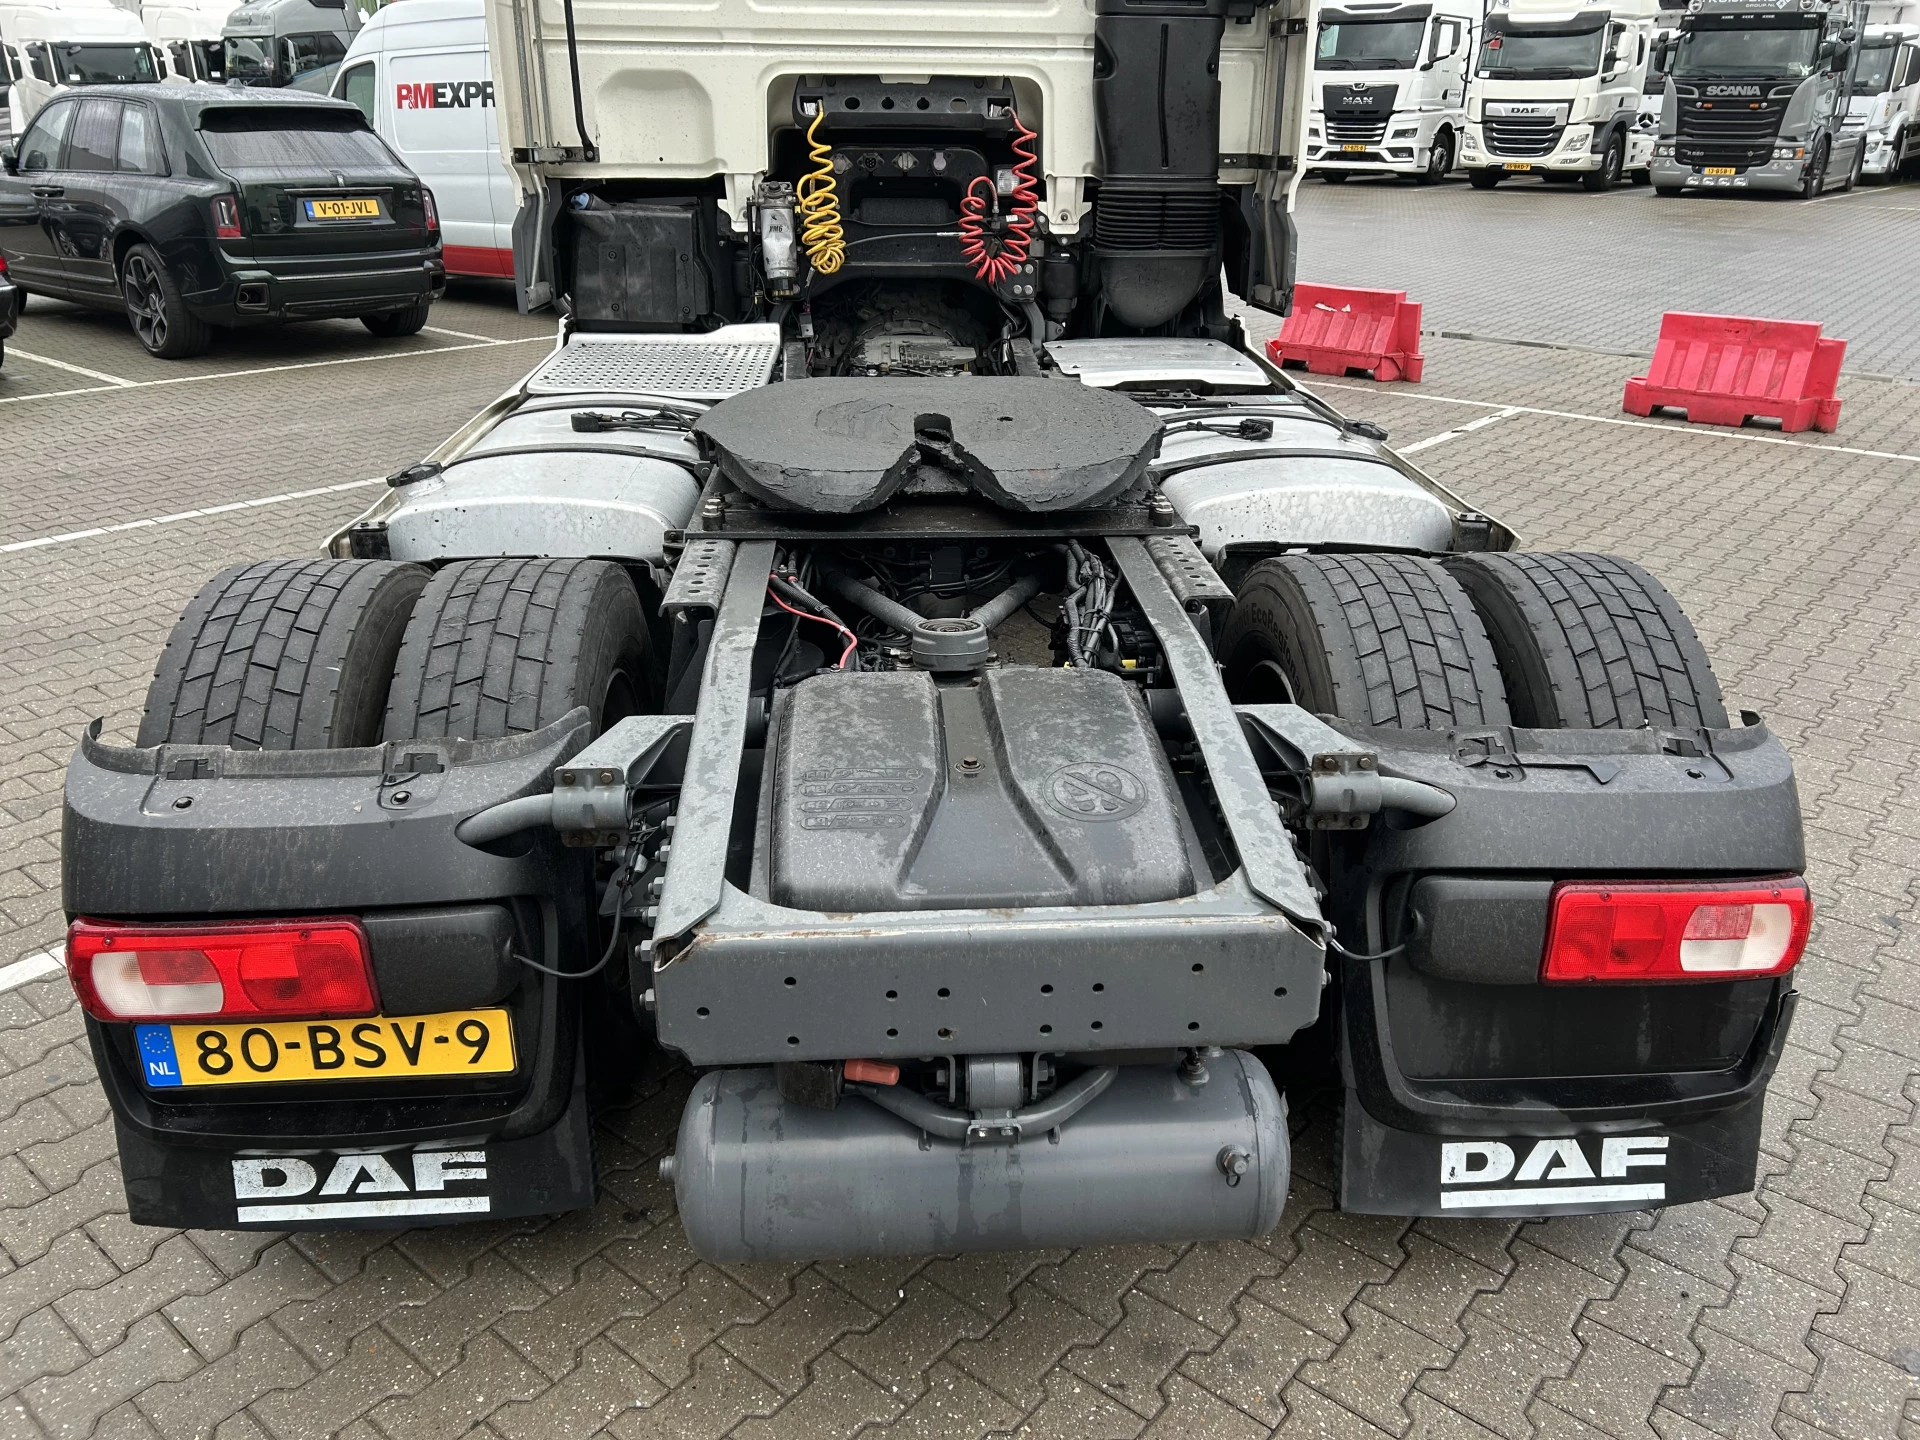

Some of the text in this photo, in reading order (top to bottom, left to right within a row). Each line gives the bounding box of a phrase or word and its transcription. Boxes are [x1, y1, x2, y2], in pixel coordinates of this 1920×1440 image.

[1343, 96, 1373, 105] MAN
[1706, 85, 1760, 96] SCANIA
[319, 202, 372, 215] V-01-JVL
[149, 1019, 490, 1077] NL 80-BSV-9
[1441, 1136, 1669, 1183] DAF
[231, 1151, 488, 1199] DAF
